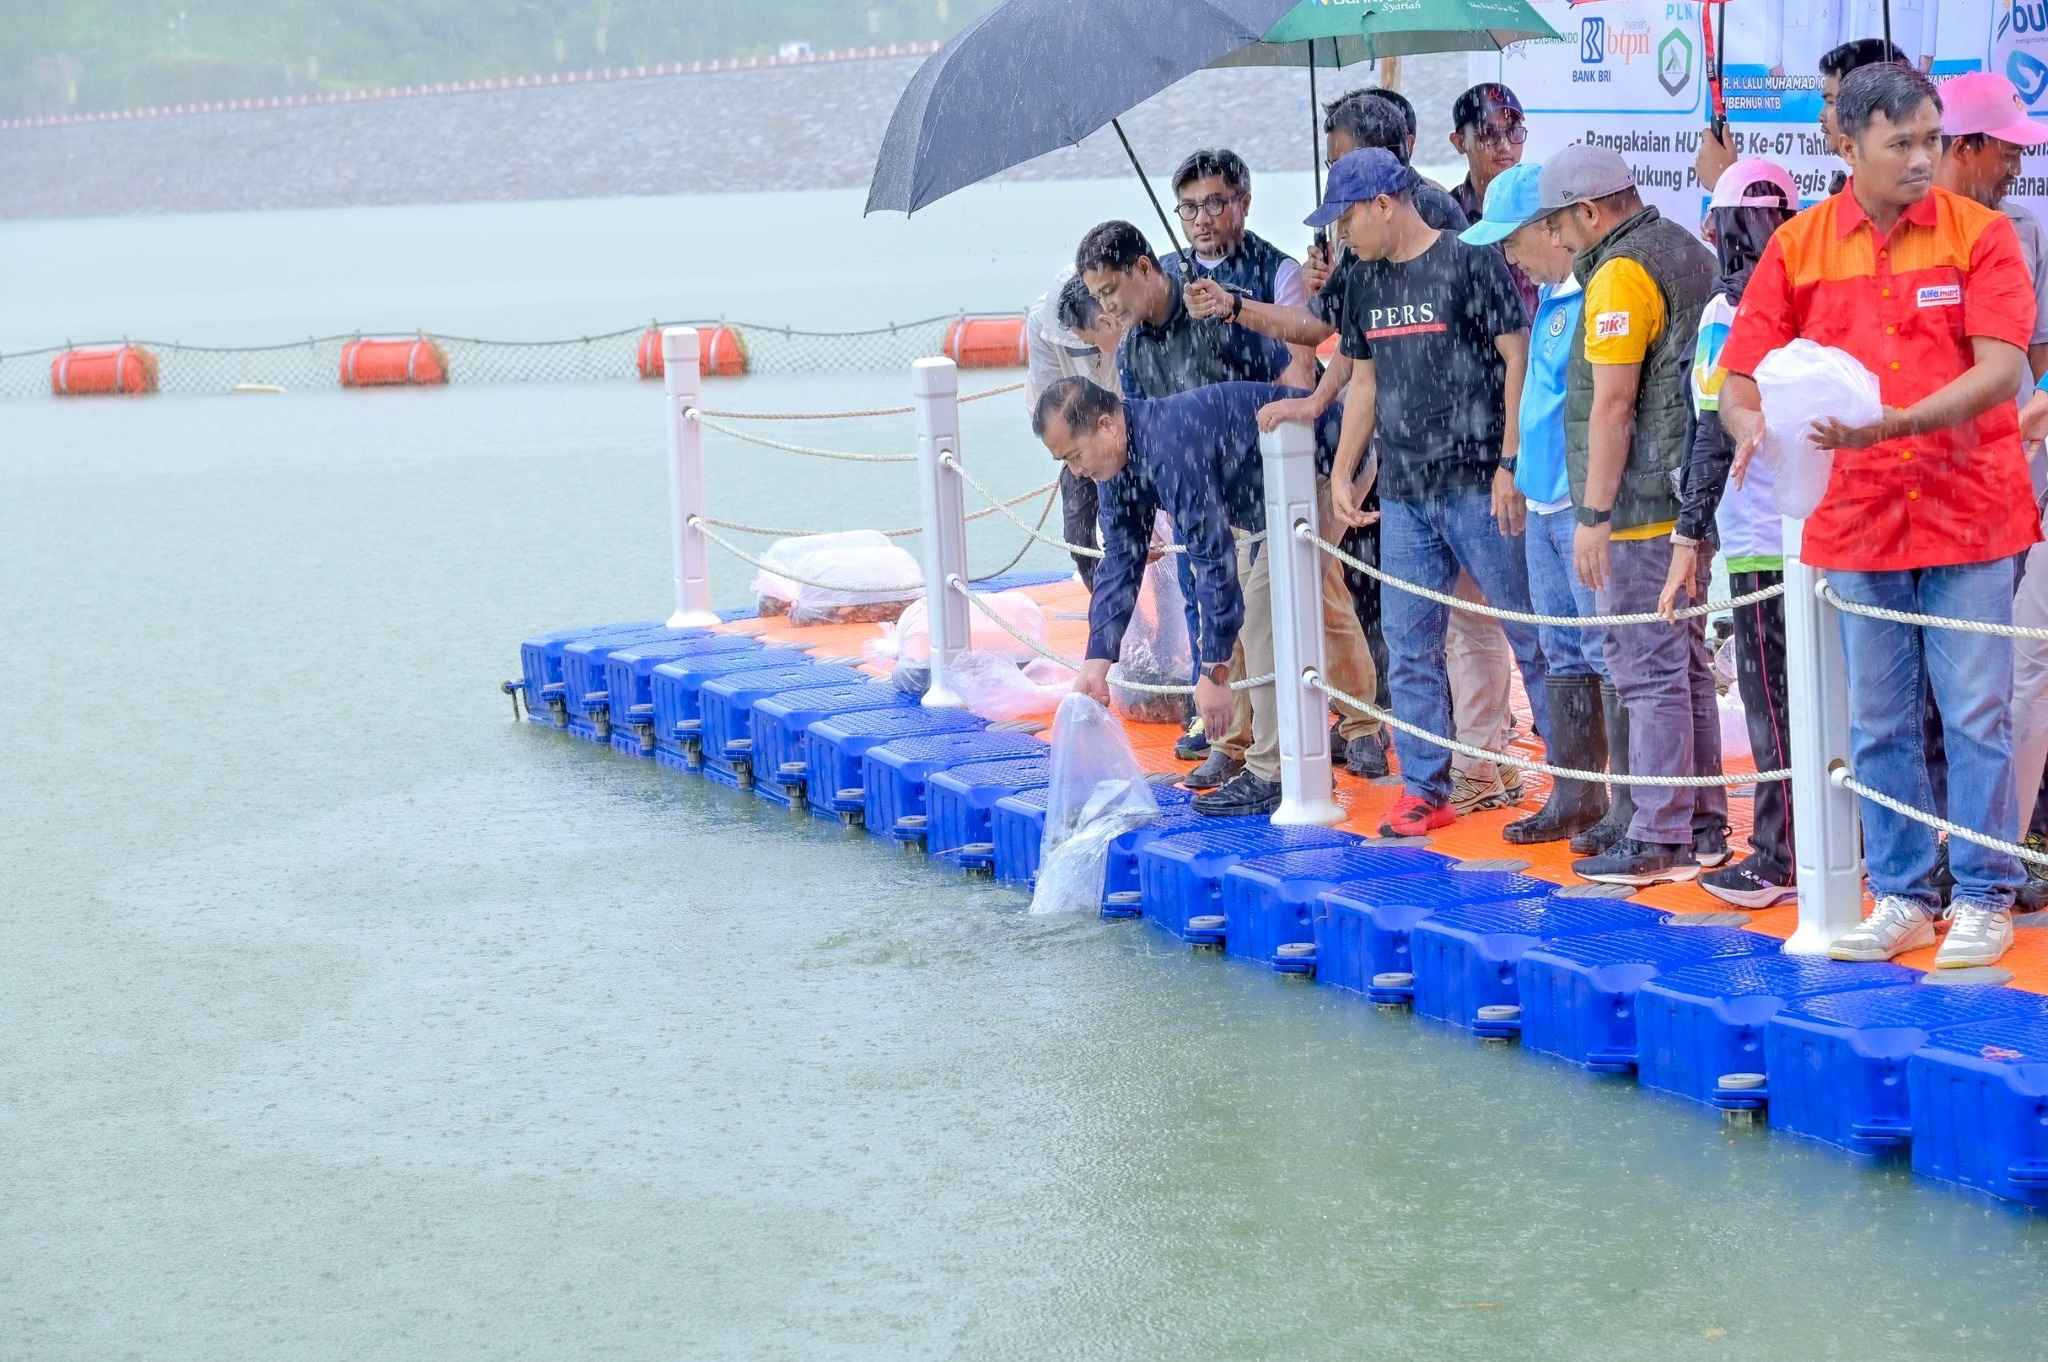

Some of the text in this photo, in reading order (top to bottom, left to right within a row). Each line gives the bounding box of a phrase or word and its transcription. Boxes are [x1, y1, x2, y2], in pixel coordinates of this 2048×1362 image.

[1665, 3, 1693, 20] PLN
[2013, 0, 2048, 33] bu
[1607, 24, 1650, 65] btpn
[1572, 70, 1612, 83] BANK BRI
[1743, 76, 1763, 89] LALU
[1765, 75, 1816, 89] MUHAMAD
[1764, 97, 1781, 109] NTB
[1586, 130, 1670, 154] Rangakaian
[1749, 133, 1793, 155] Ke-67
[1370, 303, 1434, 328] PERS
